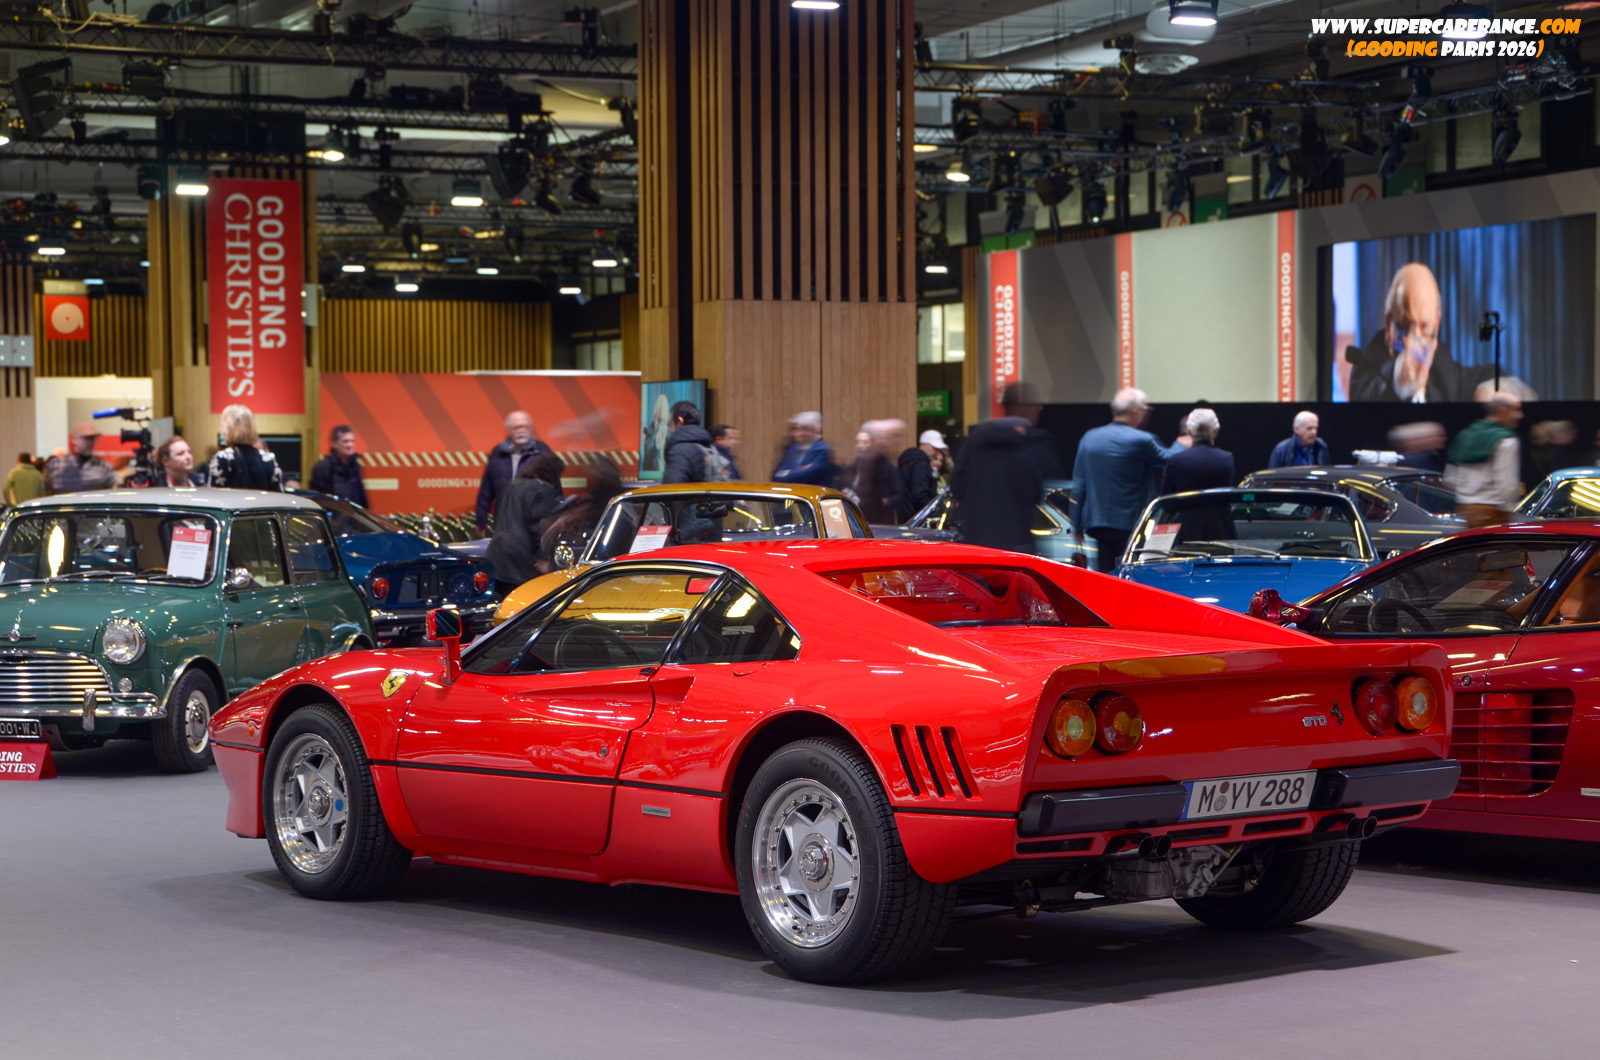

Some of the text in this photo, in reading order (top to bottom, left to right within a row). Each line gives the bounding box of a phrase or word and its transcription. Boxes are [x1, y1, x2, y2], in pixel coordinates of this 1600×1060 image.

[225, 193, 254, 397] CHRISTIE'S
[257, 195, 287, 349] GOODING
[1004, 284, 1015, 376] GOODING
[1302, 715, 1328, 728] GTO
[0, 751, 23, 762] ING
[1197, 776, 1305, 813] M YY 288
